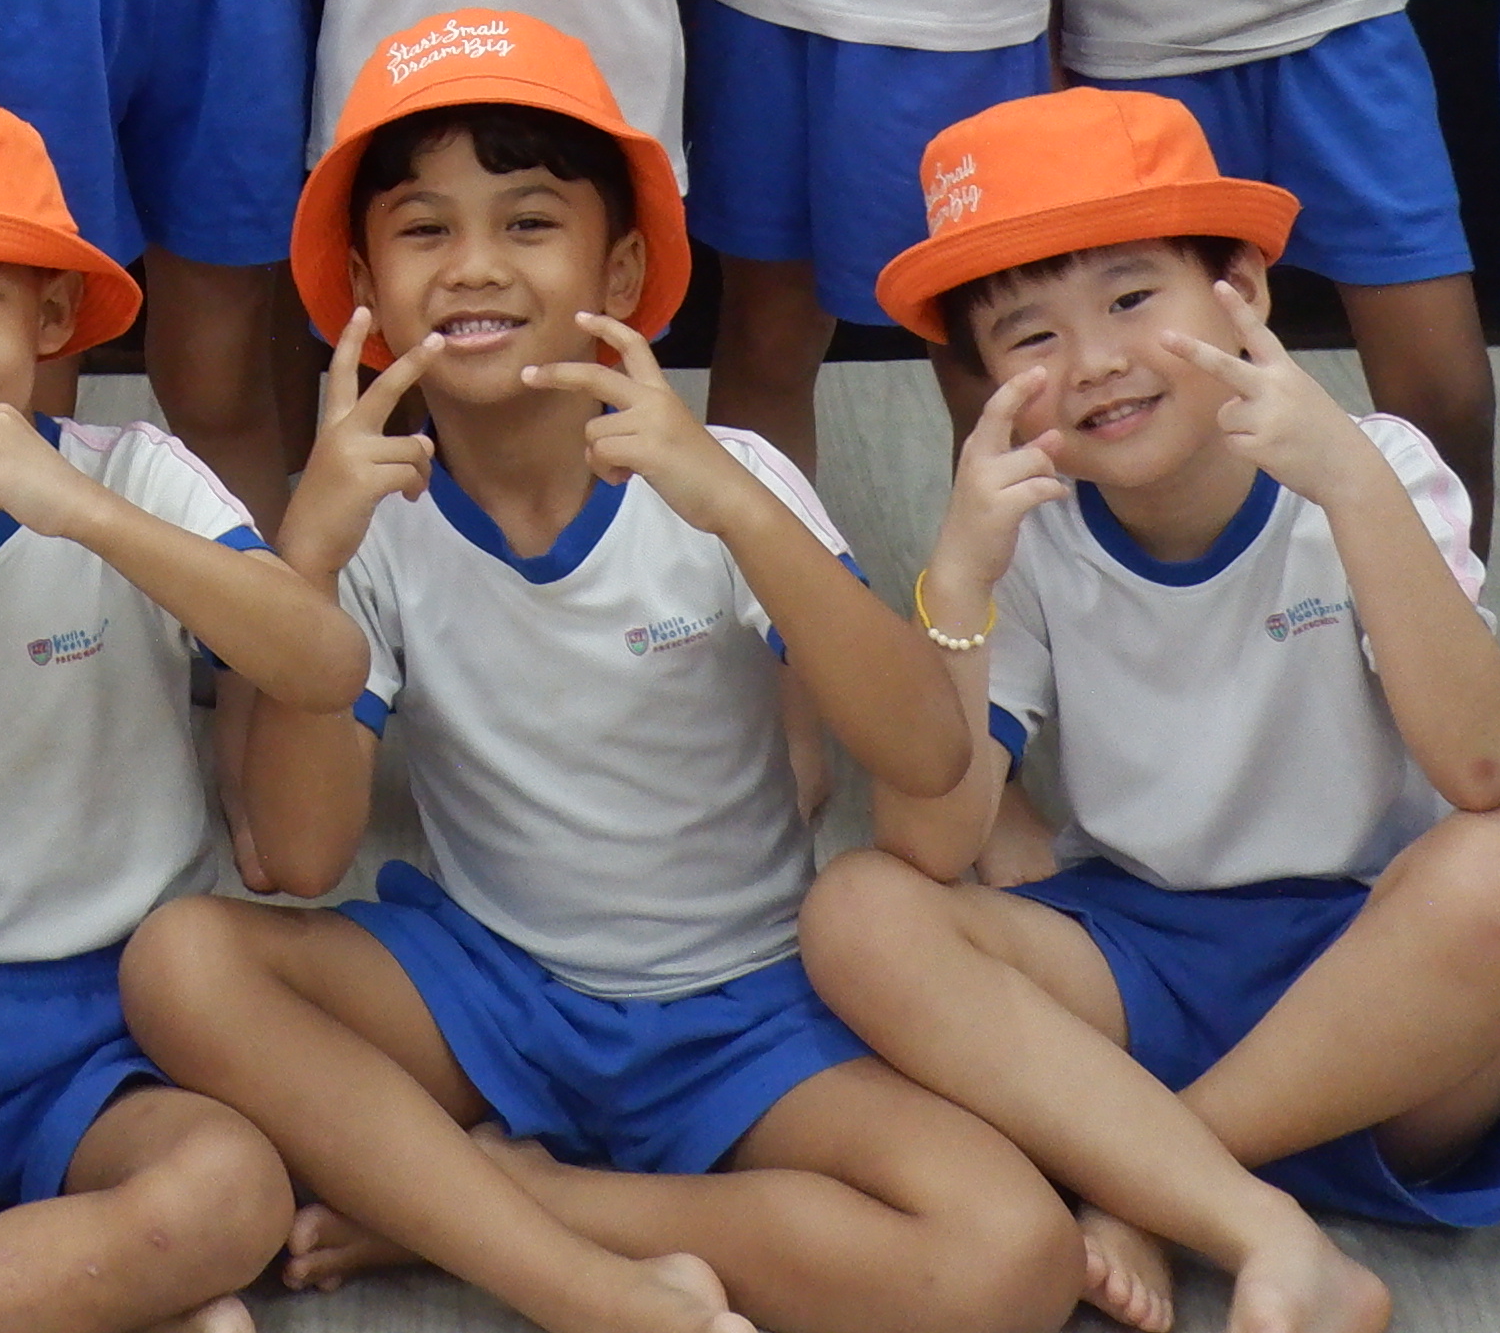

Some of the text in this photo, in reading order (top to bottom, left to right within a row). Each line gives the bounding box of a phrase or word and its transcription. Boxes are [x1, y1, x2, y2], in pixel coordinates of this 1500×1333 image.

[386, 19, 509, 64] Start Small
[387, 37, 515, 84] Dream Big
